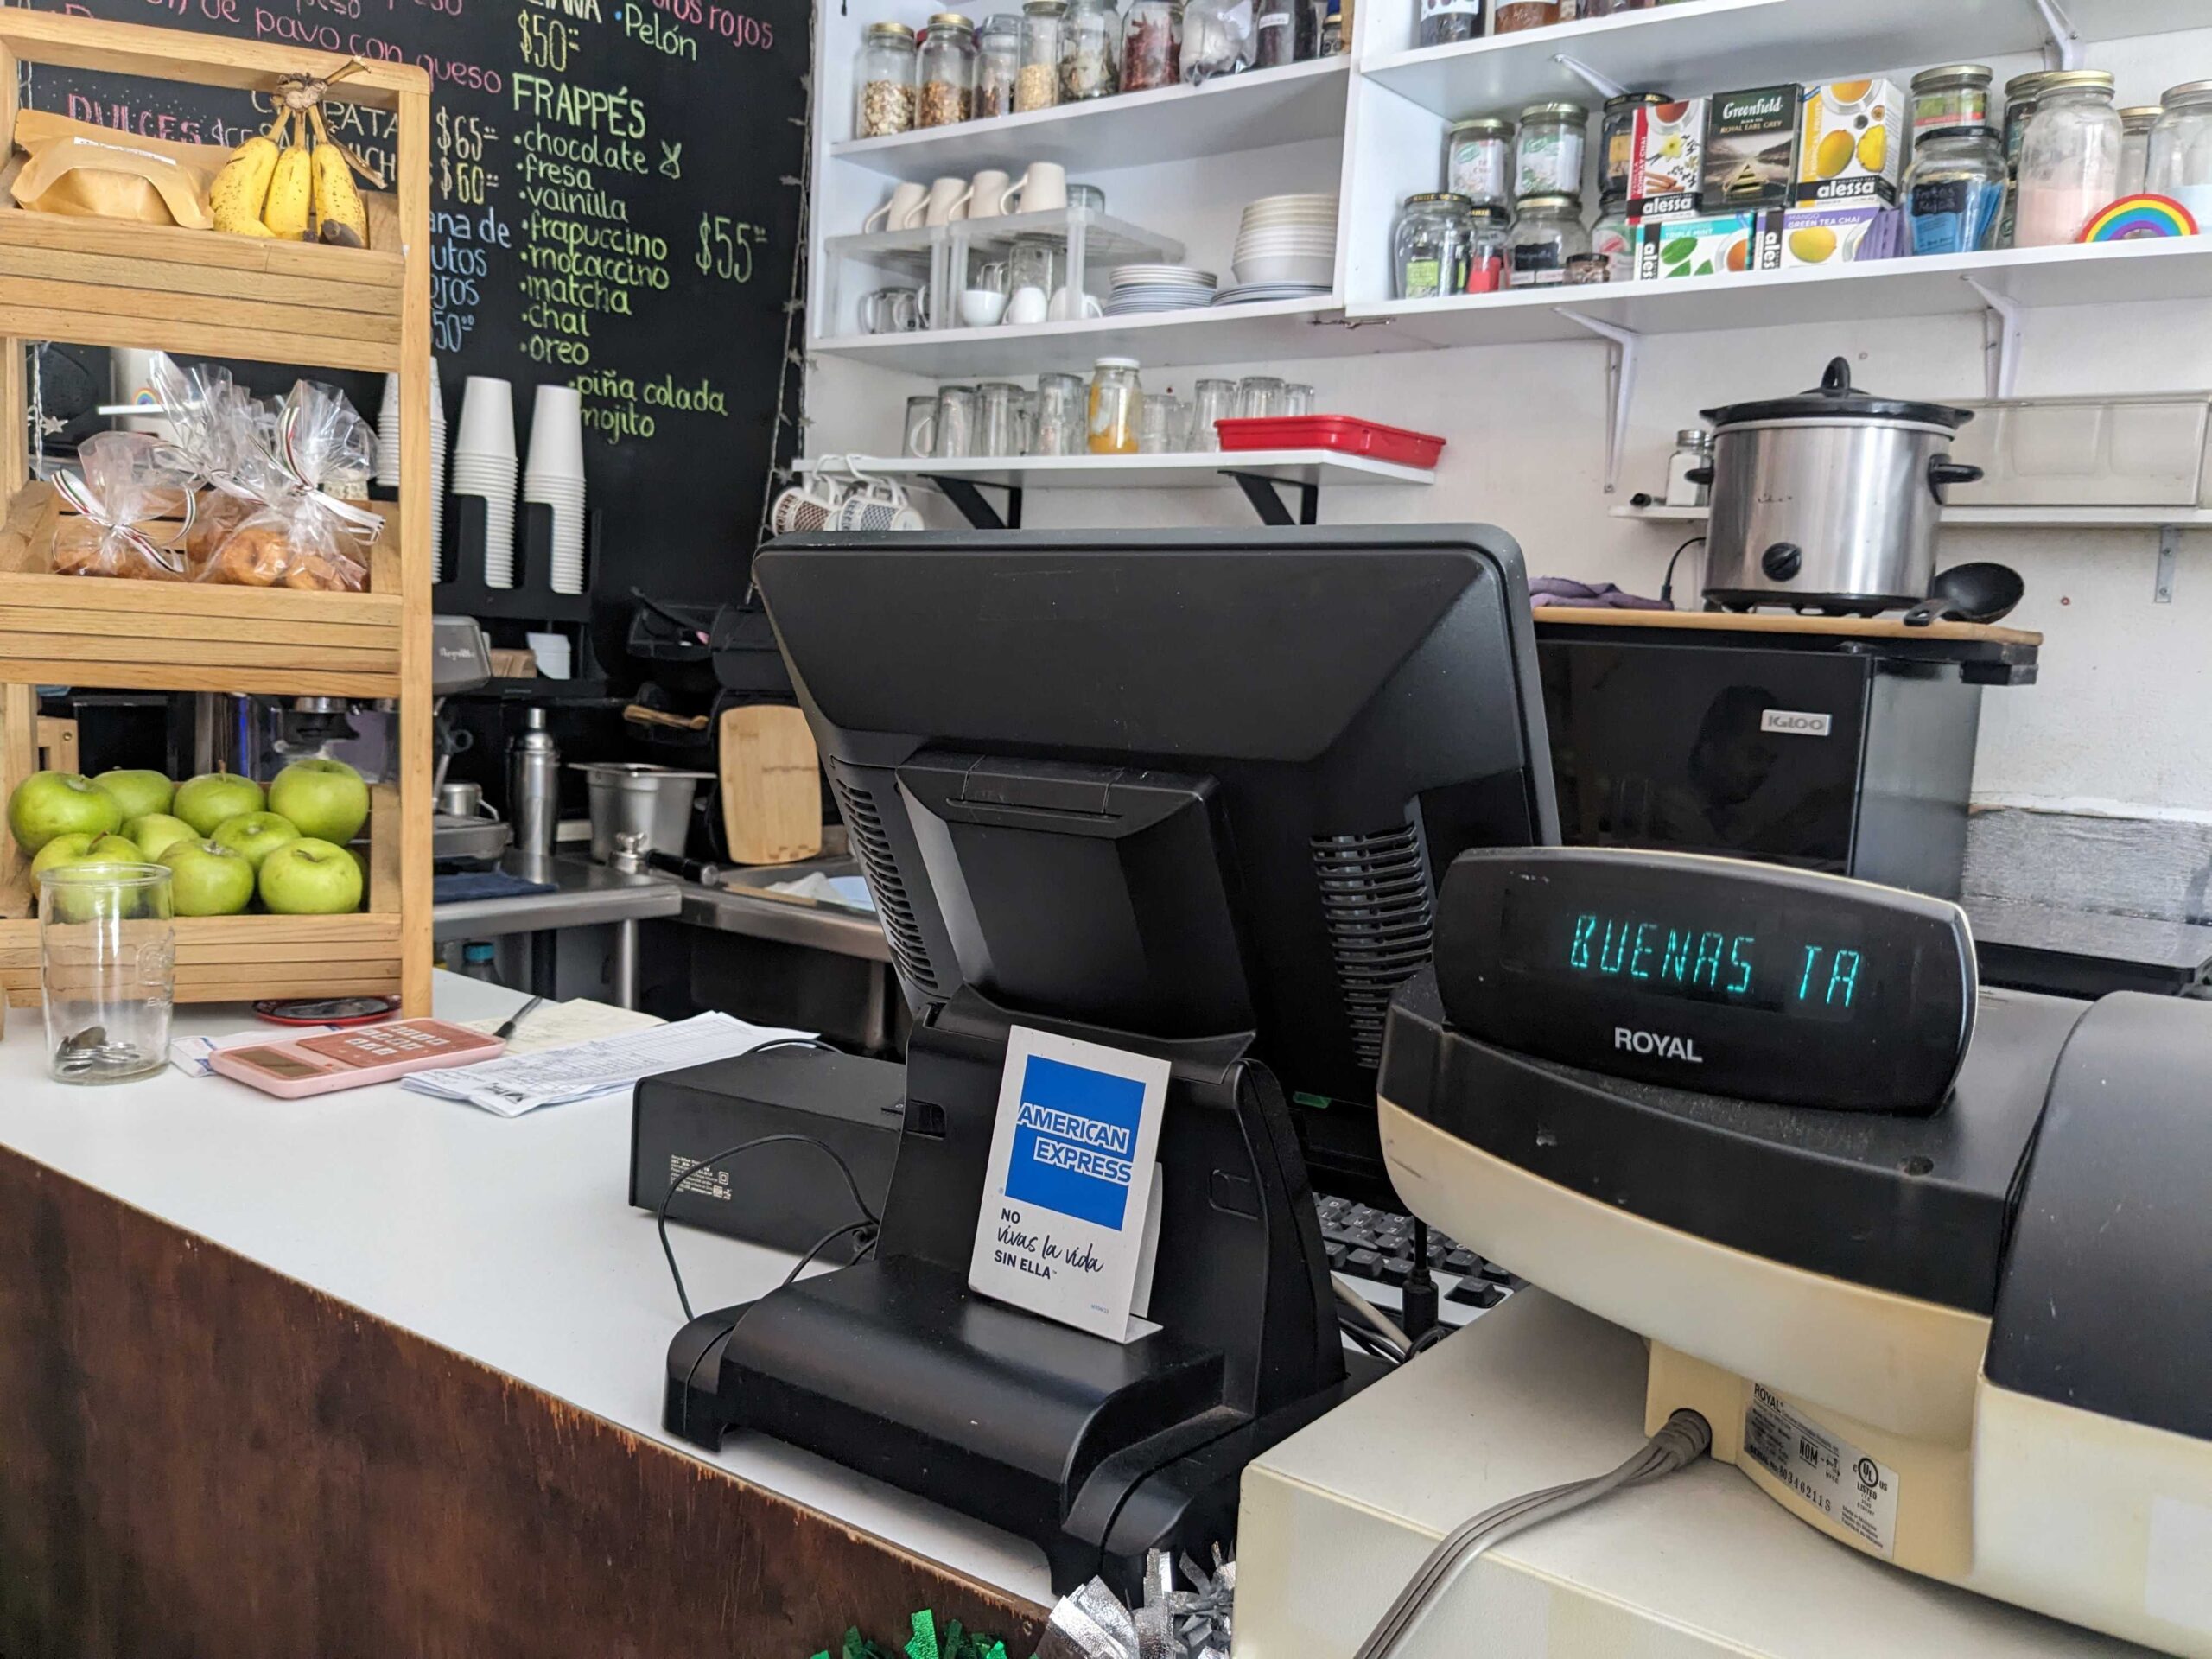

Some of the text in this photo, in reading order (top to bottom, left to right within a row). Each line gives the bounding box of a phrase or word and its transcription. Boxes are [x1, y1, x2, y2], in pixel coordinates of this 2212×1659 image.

[625, 3, 697, 61] Pelón
[709, 5, 774, 50] rojos
[256, 7, 340, 50] pavo
[349, 34, 403, 62] con
[416, 54, 502, 94] queso
[512, 72, 646, 139] FRAPPÉS
[1723, 96, 1782, 120] Greenfield
[1719, 119, 1783, 135] ROYAL EARL GREY
[524, 122, 649, 175] chocolate
[526, 153, 595, 191] fresa
[1816, 180, 1875, 198] alessa
[527, 186, 630, 223] vainilla
[1643, 197, 1692, 214] alessa
[479, 206, 512, 249] de
[531, 209, 668, 261] frapuccino
[1788, 219, 1817, 228] GREEN
[527, 243, 670, 290] mocaccino
[1643, 243, 1658, 280] ales
[527, 274, 632, 315] matcha
[529, 302, 590, 337] chai
[530, 334, 591, 365] oreo
[577, 370, 728, 416] piña colada
[1768, 715, 1824, 731] IGLOO
[1570, 914, 1859, 1007] BUENAS TA
[1614, 1027, 1703, 1064] ROYAL
[1017, 1101, 1130, 1154] AMERICAN
[1033, 1135, 1134, 1187] EXPRESS
[1001, 1207, 1020, 1224] NO
[994, 1249, 1052, 1280] SIN ELLA
[998, 1224, 1105, 1273] vivas la vida
[1754, 1382, 1783, 1413] ROYAL
[1799, 1439, 1818, 1466] NOM
[1857, 1481, 1878, 1501] LISTED
